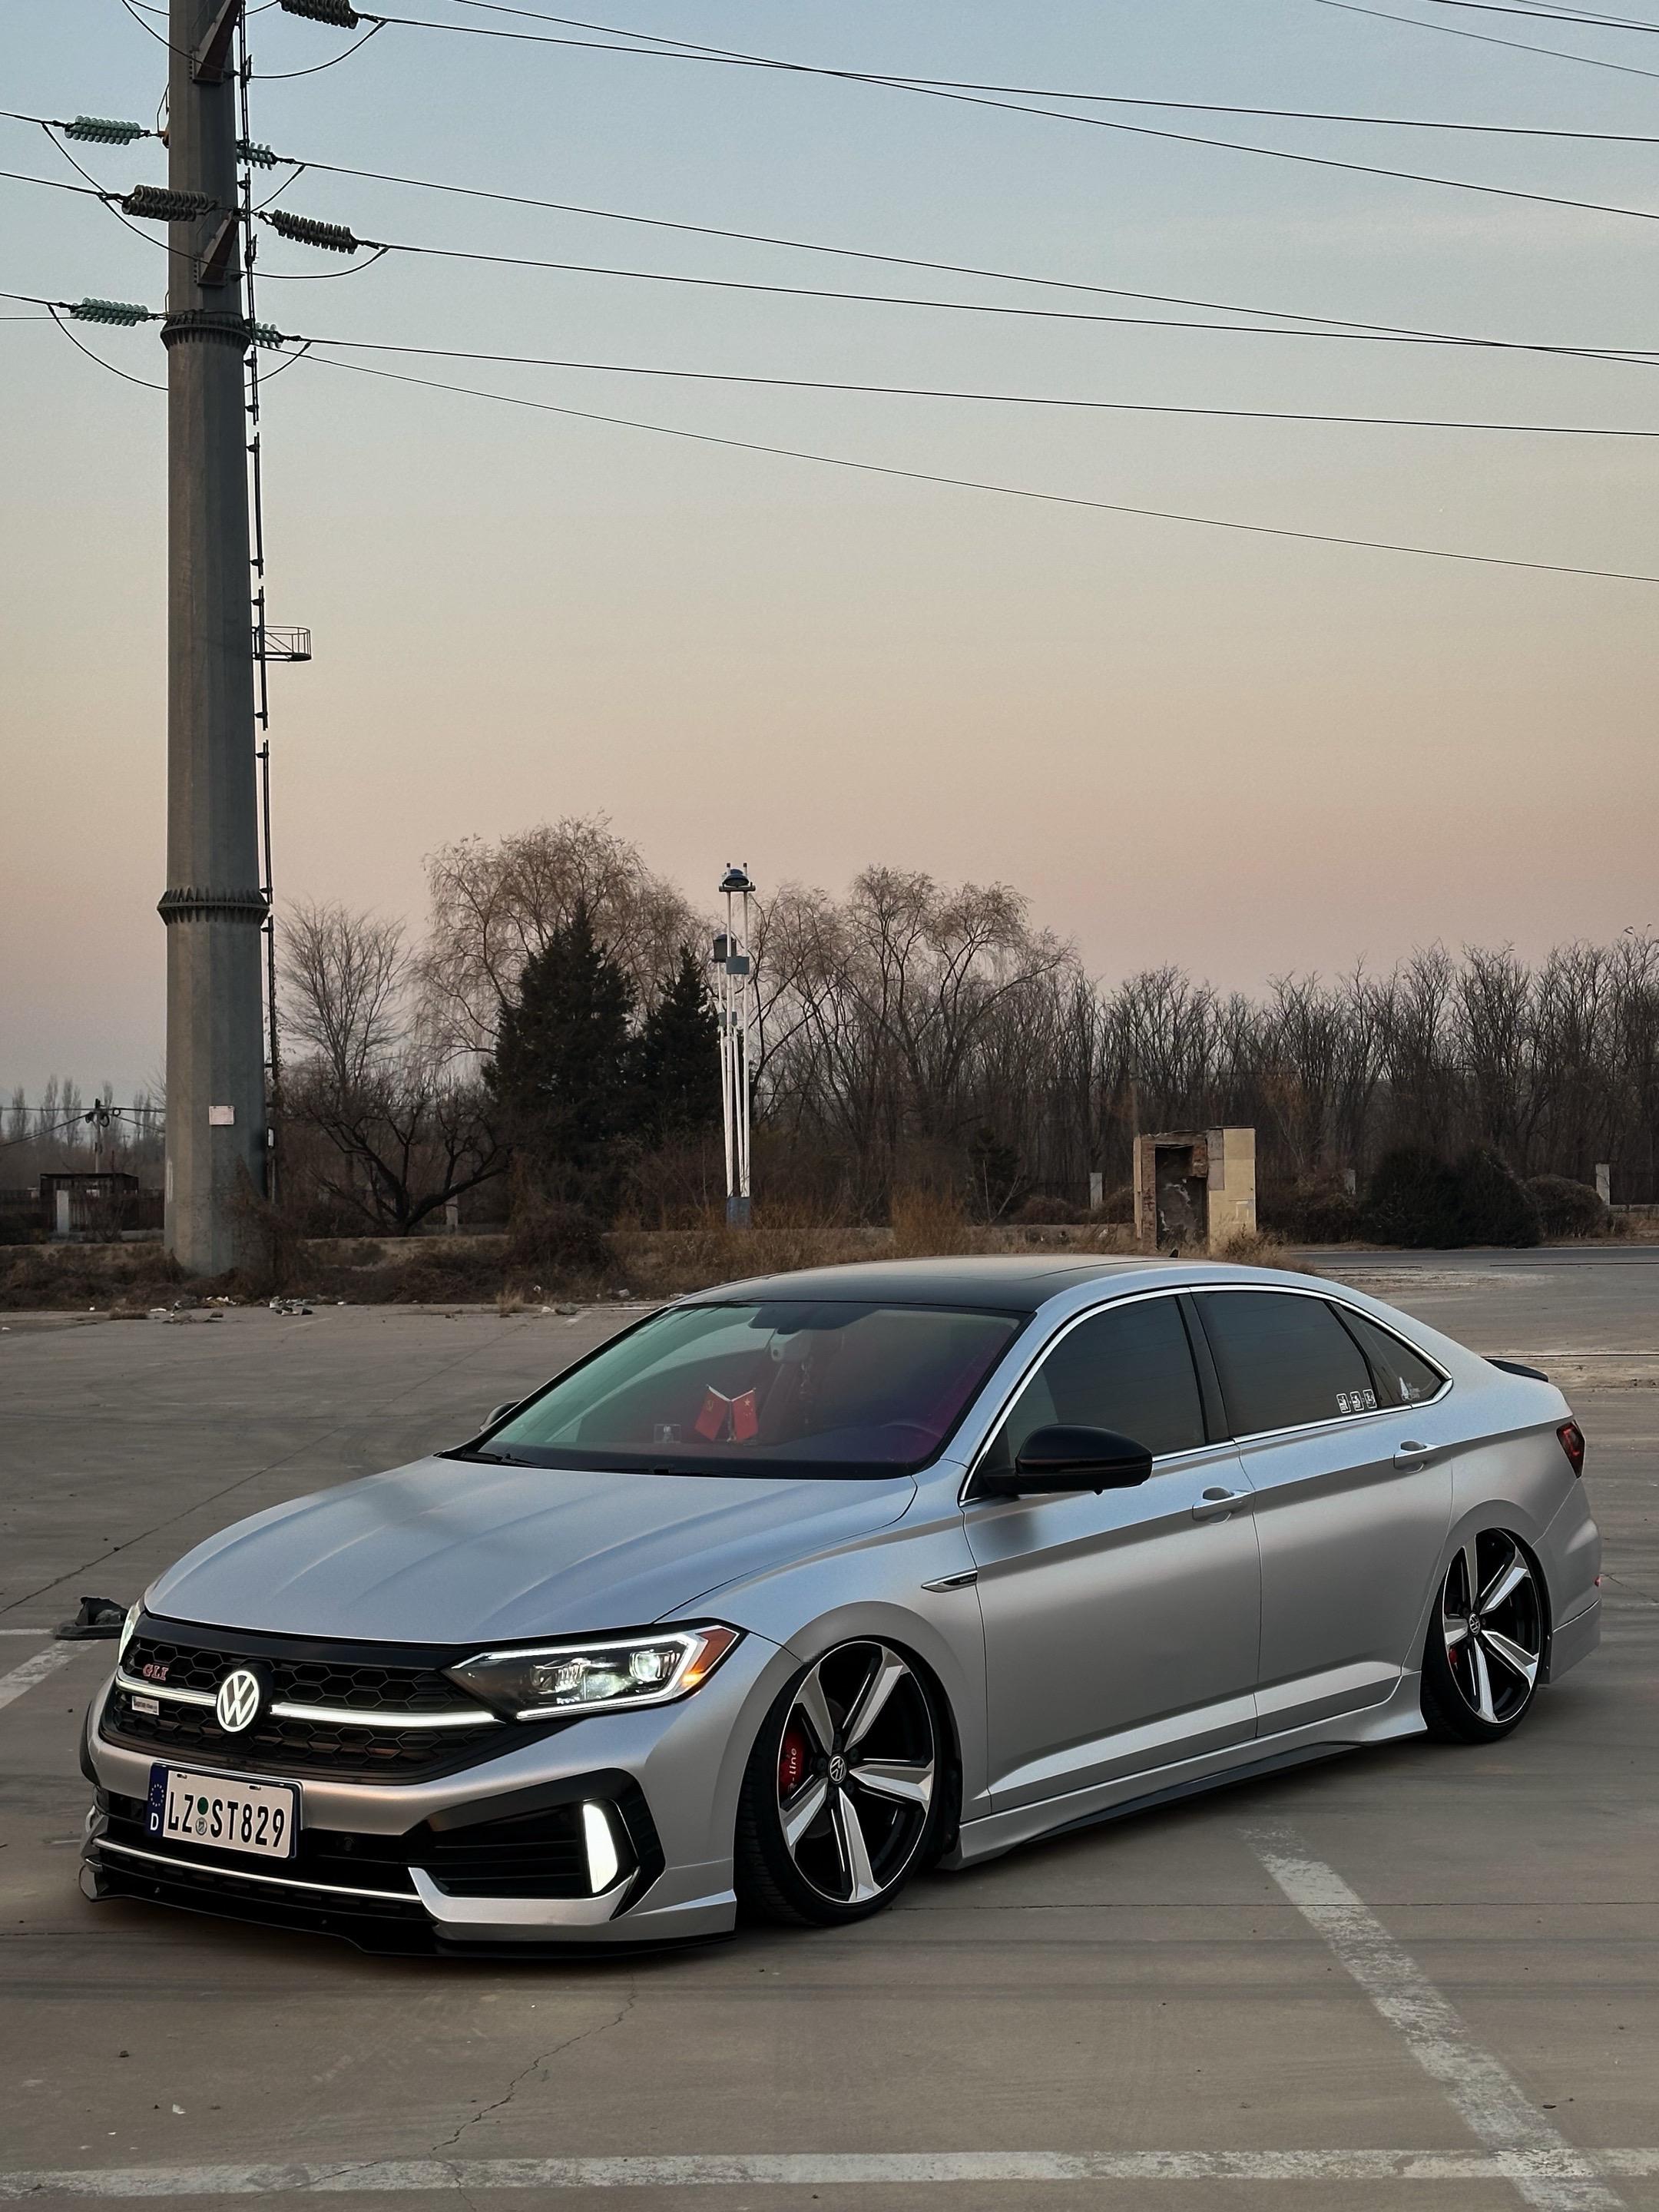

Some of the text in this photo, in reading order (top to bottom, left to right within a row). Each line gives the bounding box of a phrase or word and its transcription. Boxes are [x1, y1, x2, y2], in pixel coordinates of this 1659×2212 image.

[143, 1664, 169, 1681] GLI
[217, 1671, 260, 1732] VW
[150, 1813, 159, 1831] D
